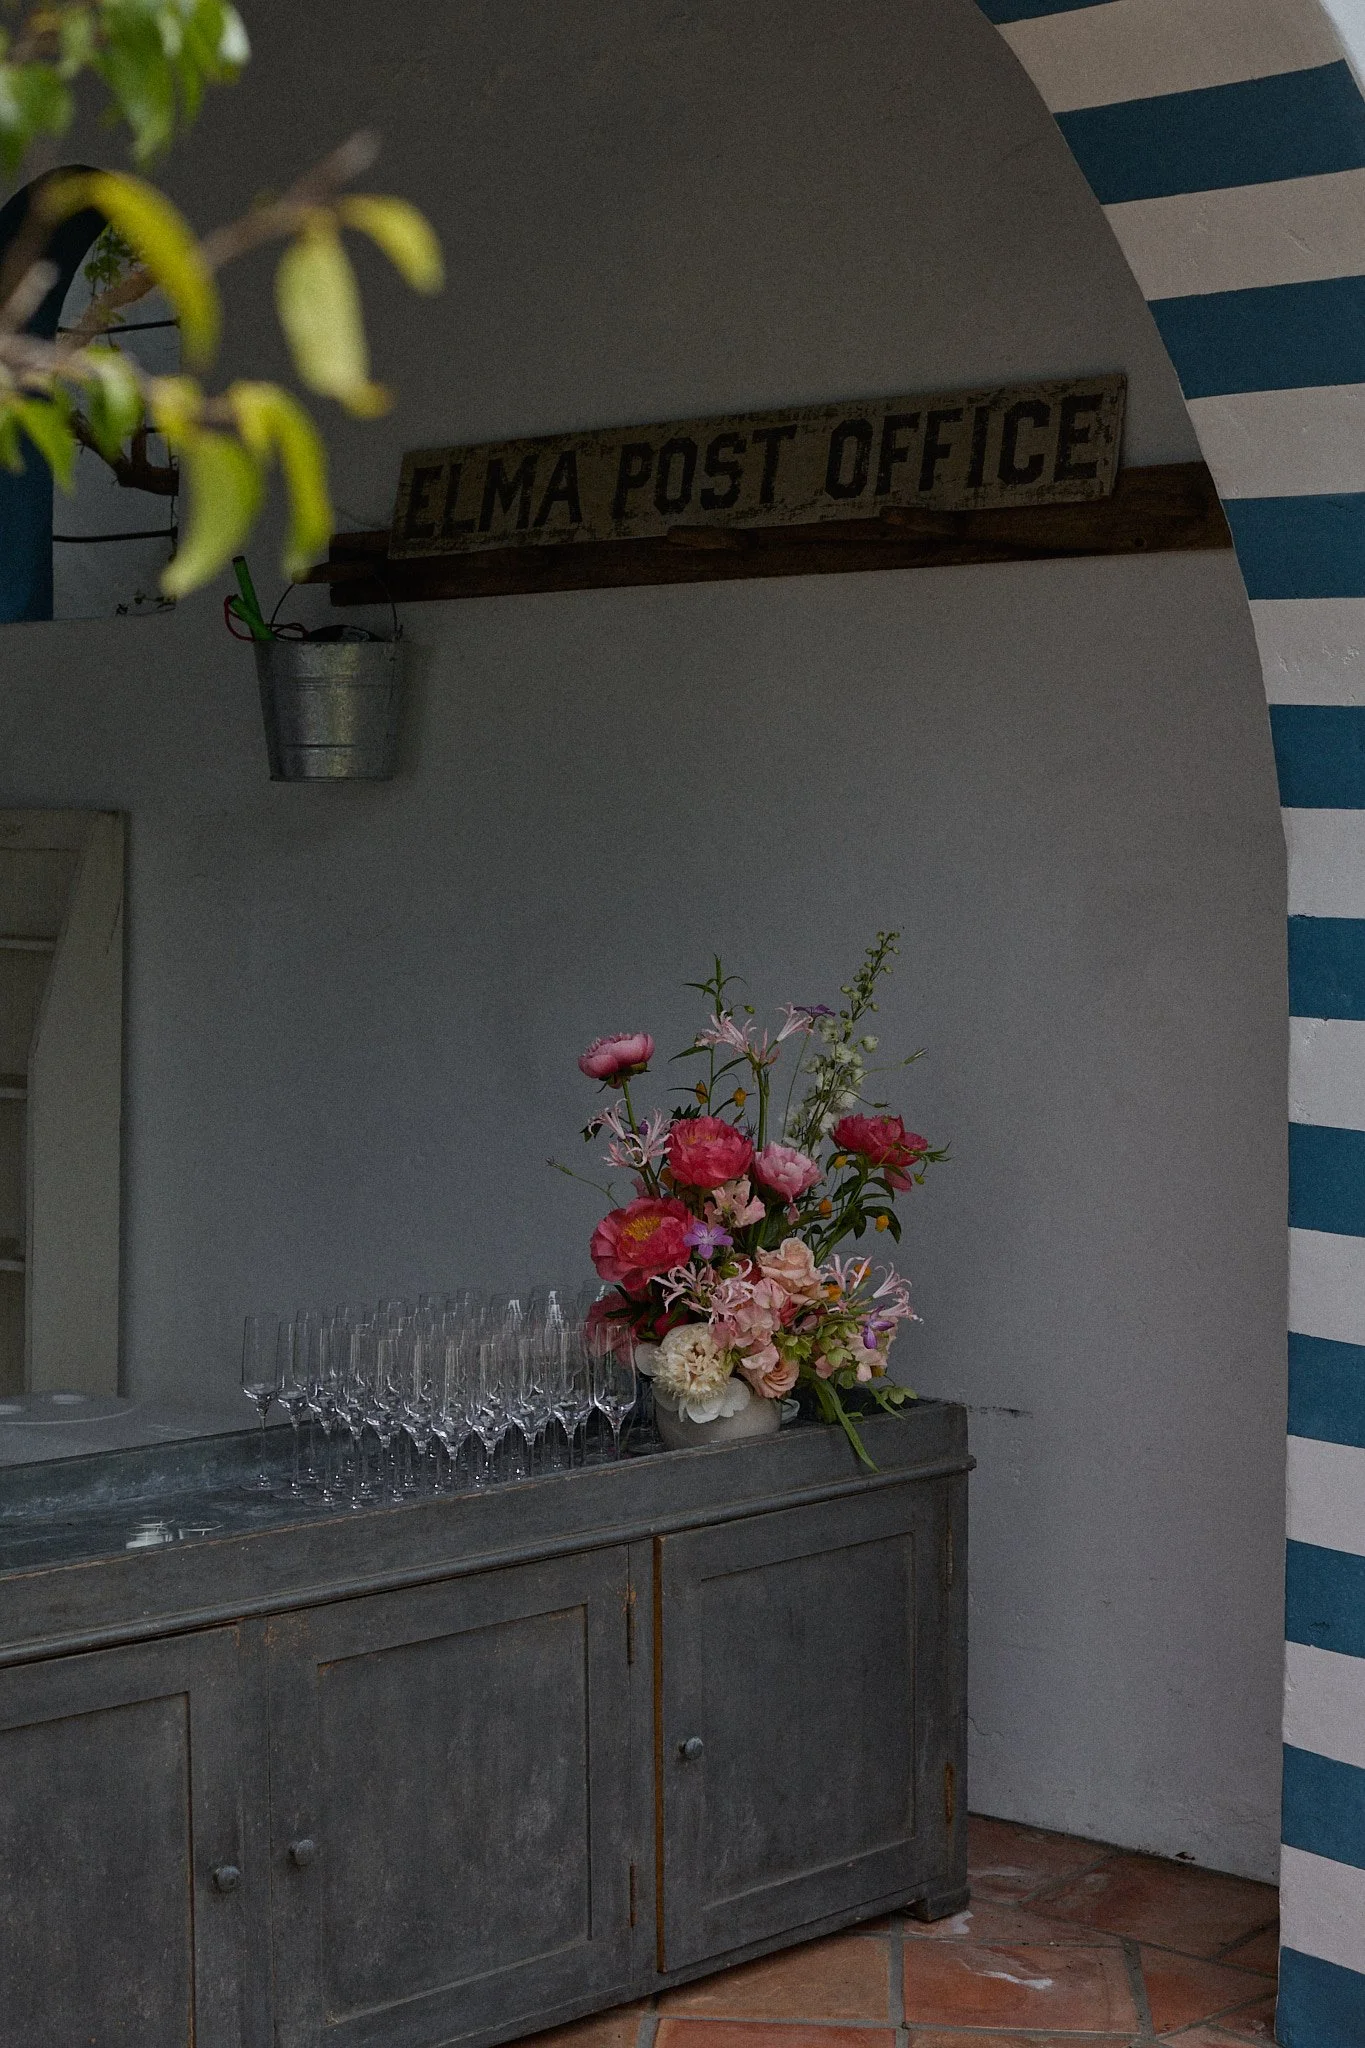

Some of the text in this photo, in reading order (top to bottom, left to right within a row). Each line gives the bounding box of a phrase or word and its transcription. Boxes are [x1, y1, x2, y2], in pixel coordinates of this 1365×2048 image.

[403, 394, 1103, 540] ELMA POST OFFICE
